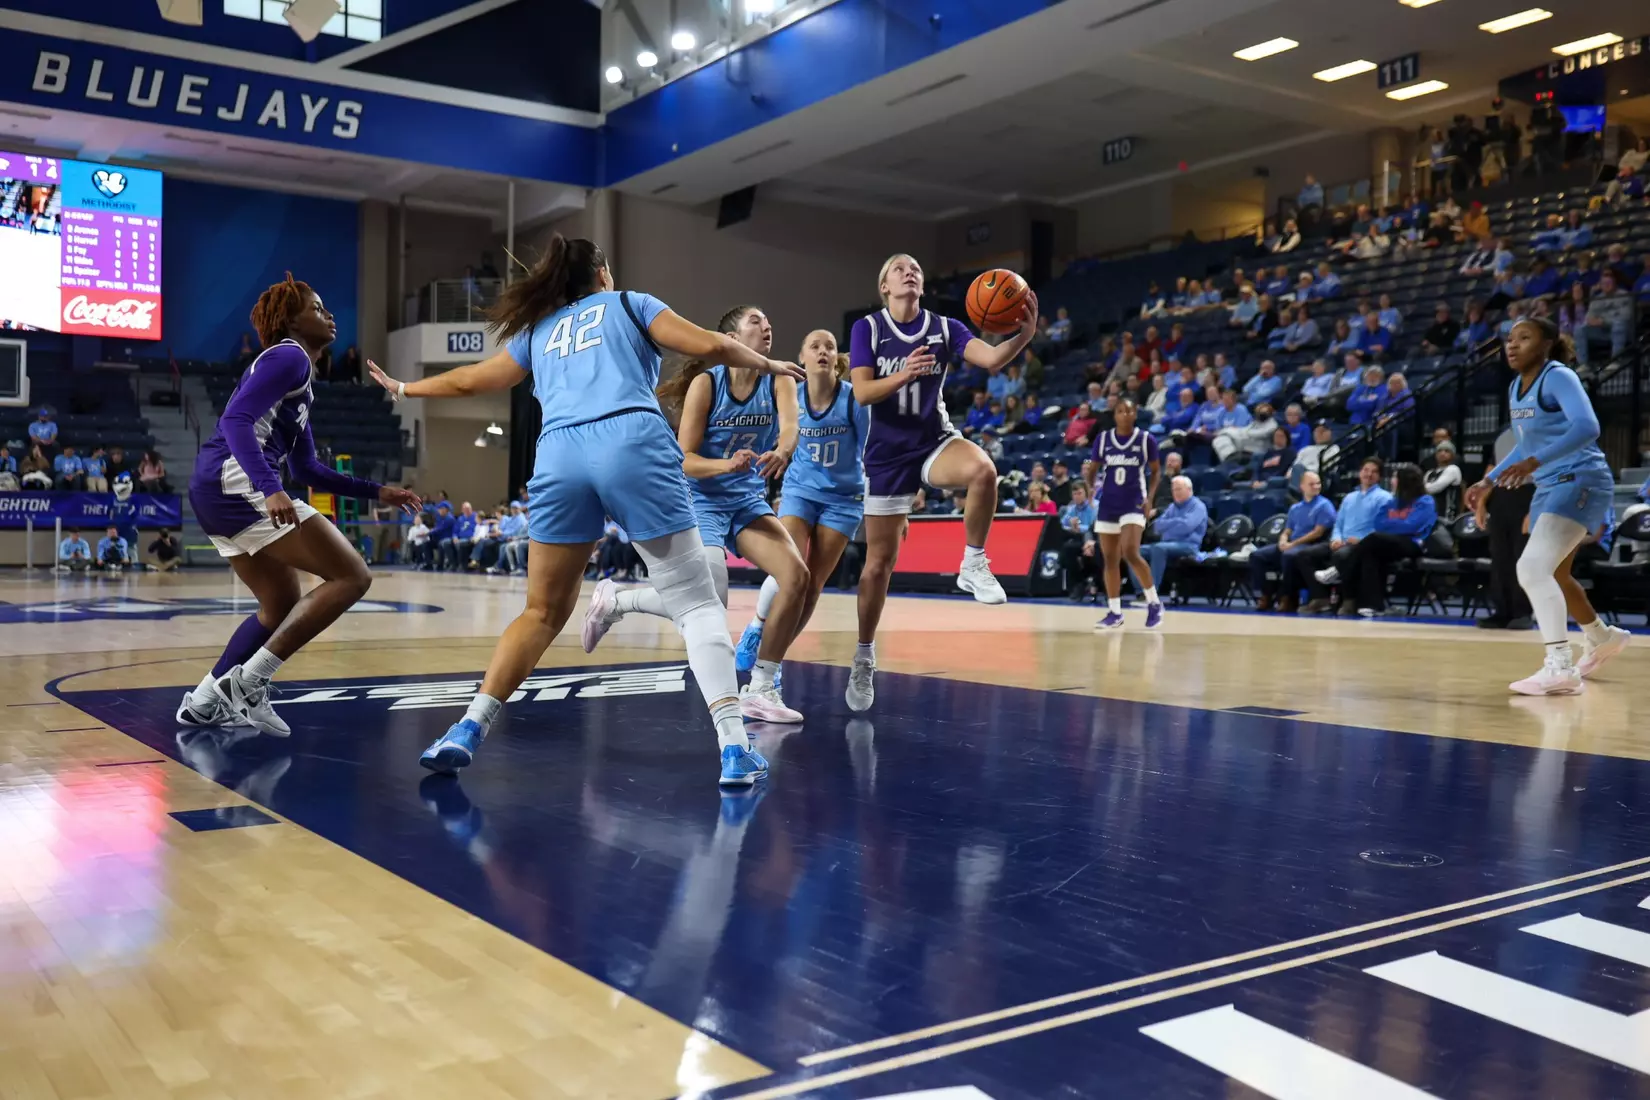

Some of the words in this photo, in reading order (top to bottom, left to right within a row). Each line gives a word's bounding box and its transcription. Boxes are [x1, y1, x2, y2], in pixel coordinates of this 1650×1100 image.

[1382, 58, 1414, 85] 111
[32, 51, 363, 139] BLUEJAYS
[1106, 139, 1131, 161] 110
[82, 198, 137, 212] METHODIST
[63, 295, 157, 330] Coca-Cola
[449, 333, 482, 351] 108
[543, 303, 607, 359] 42
[877, 356, 941, 376] Wilats
[897, 381, 920, 415] 11
[799, 426, 847, 438] REIGHTON
[723, 433, 758, 458] 13
[807, 440, 839, 468] 30
[1105, 454, 1140, 466] Wildcats
[1115, 467, 1126, 486] 0
